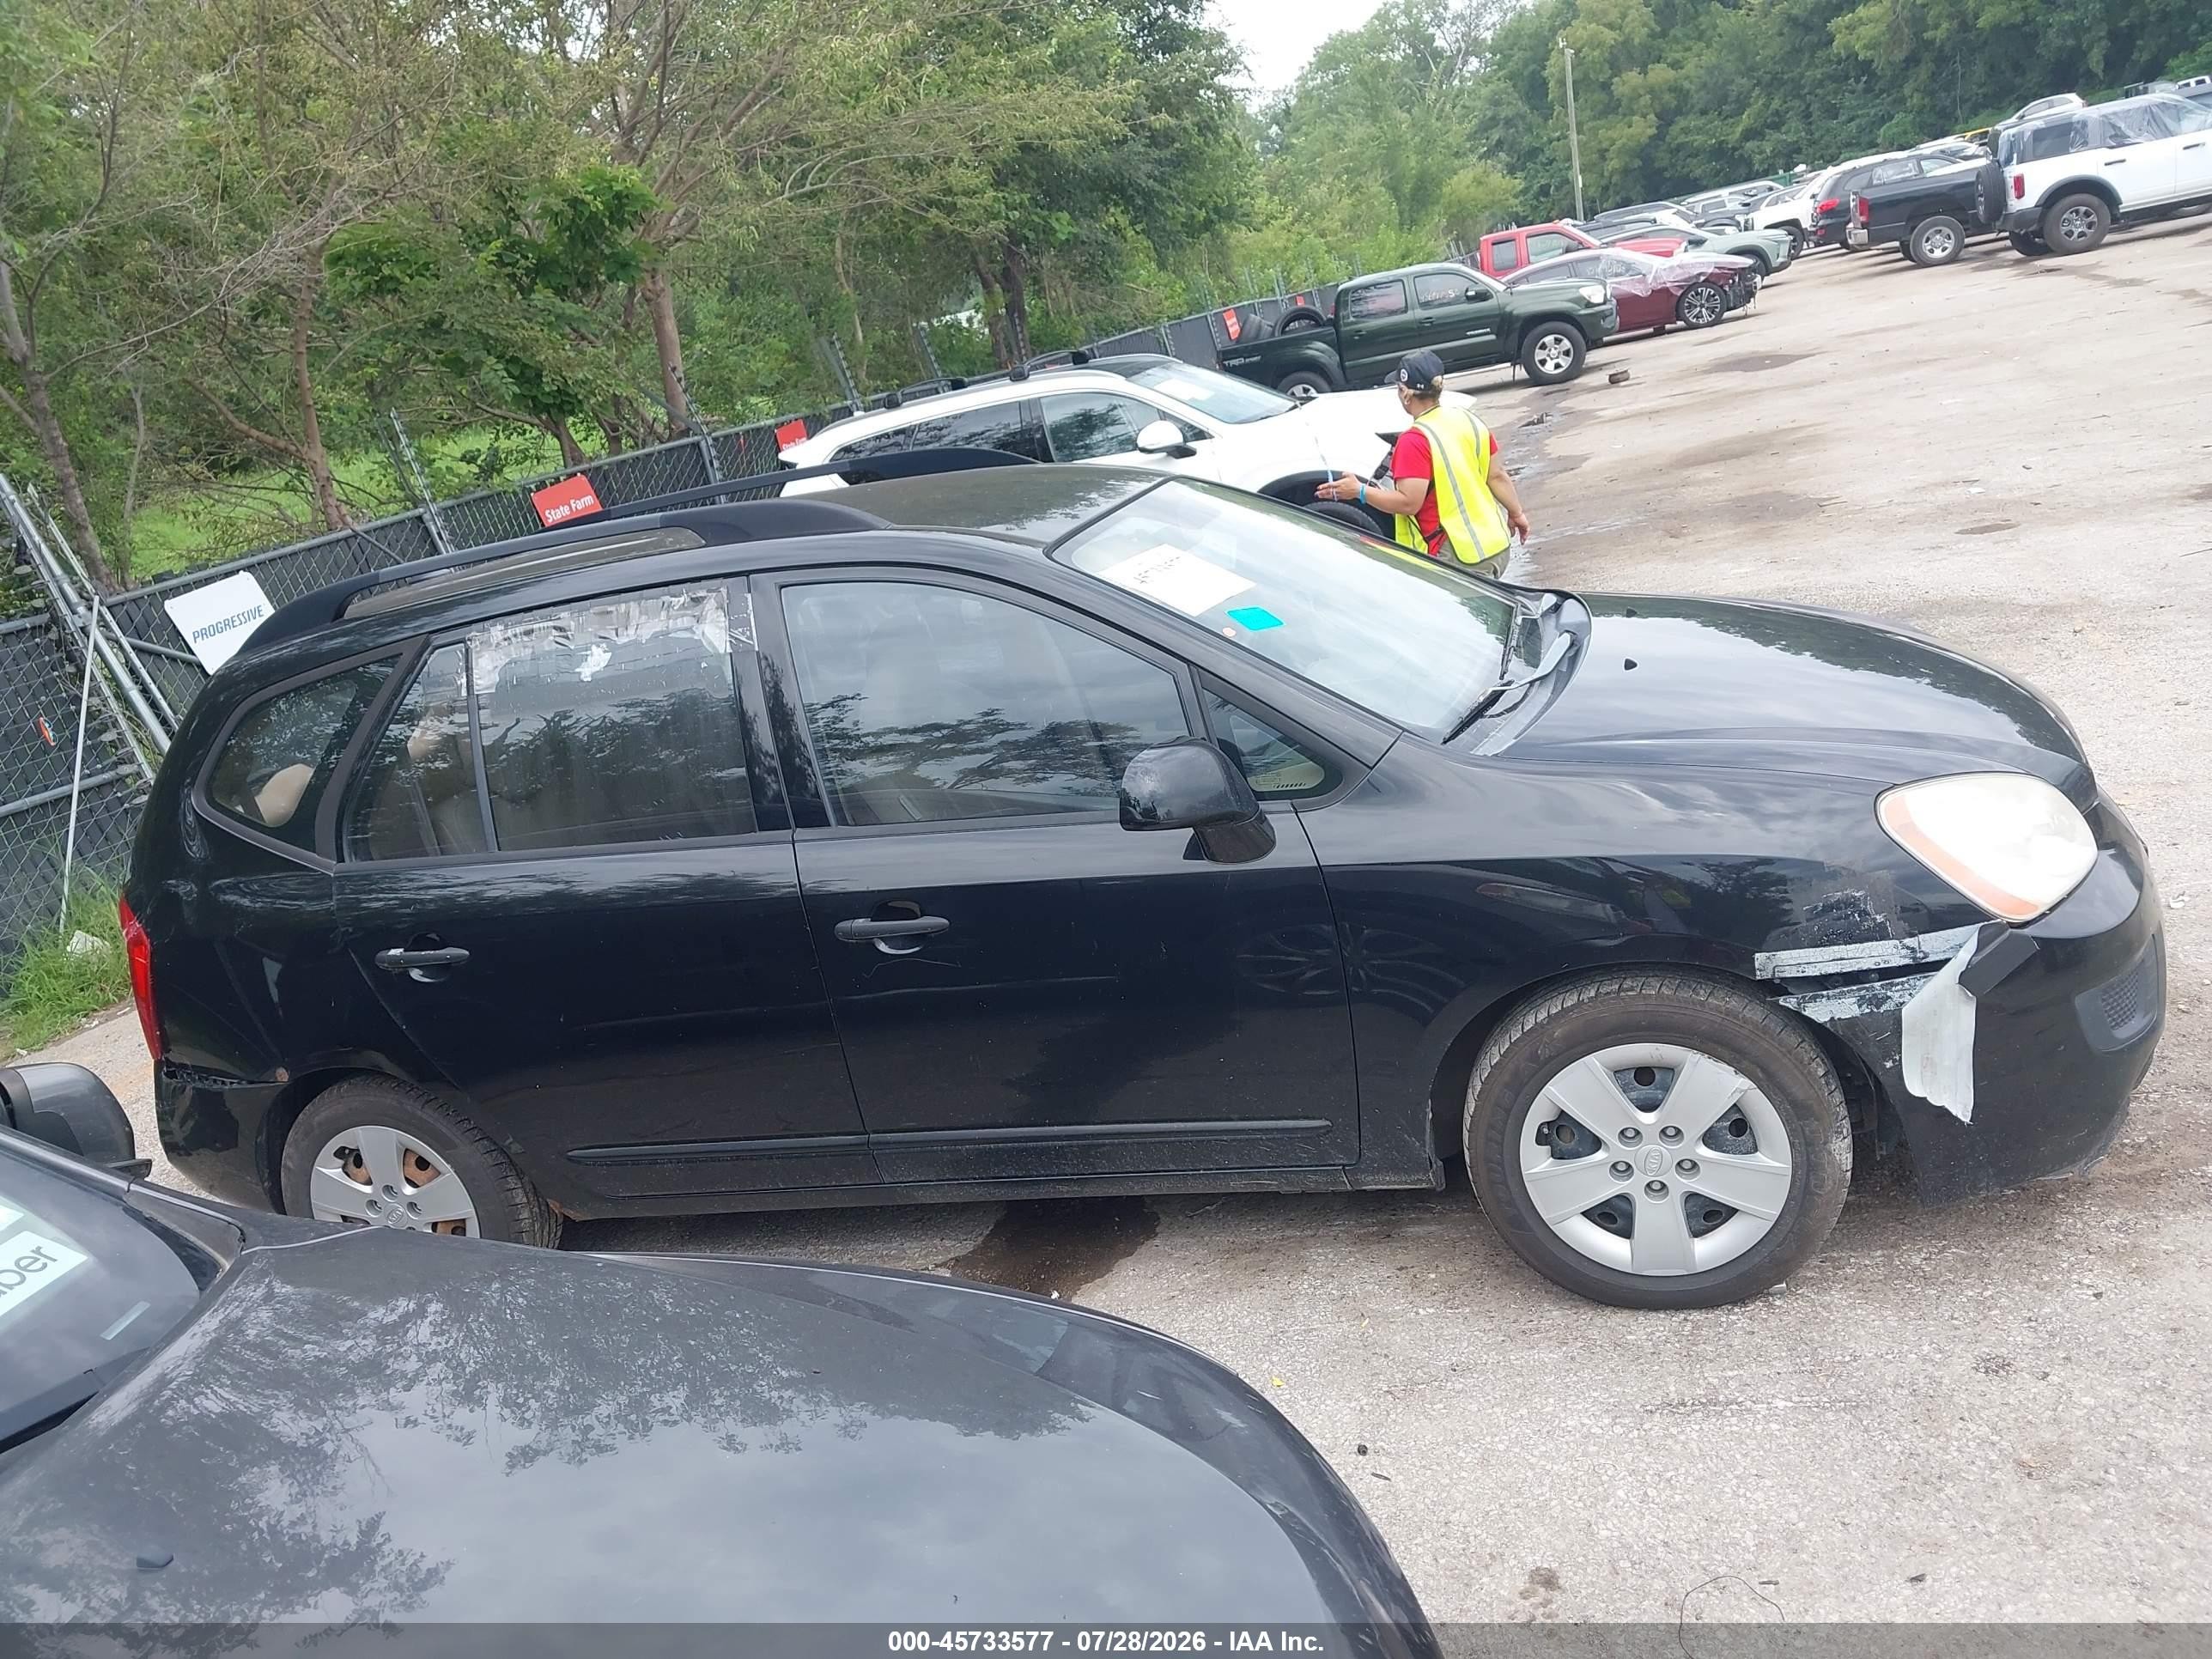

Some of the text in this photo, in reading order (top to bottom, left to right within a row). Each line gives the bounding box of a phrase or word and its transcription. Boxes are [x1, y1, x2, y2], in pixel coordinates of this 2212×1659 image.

[544, 495, 594, 523] State Farm
[191, 605, 264, 643] PROGRESSIVE
[0, 1245, 58, 1297] ber
